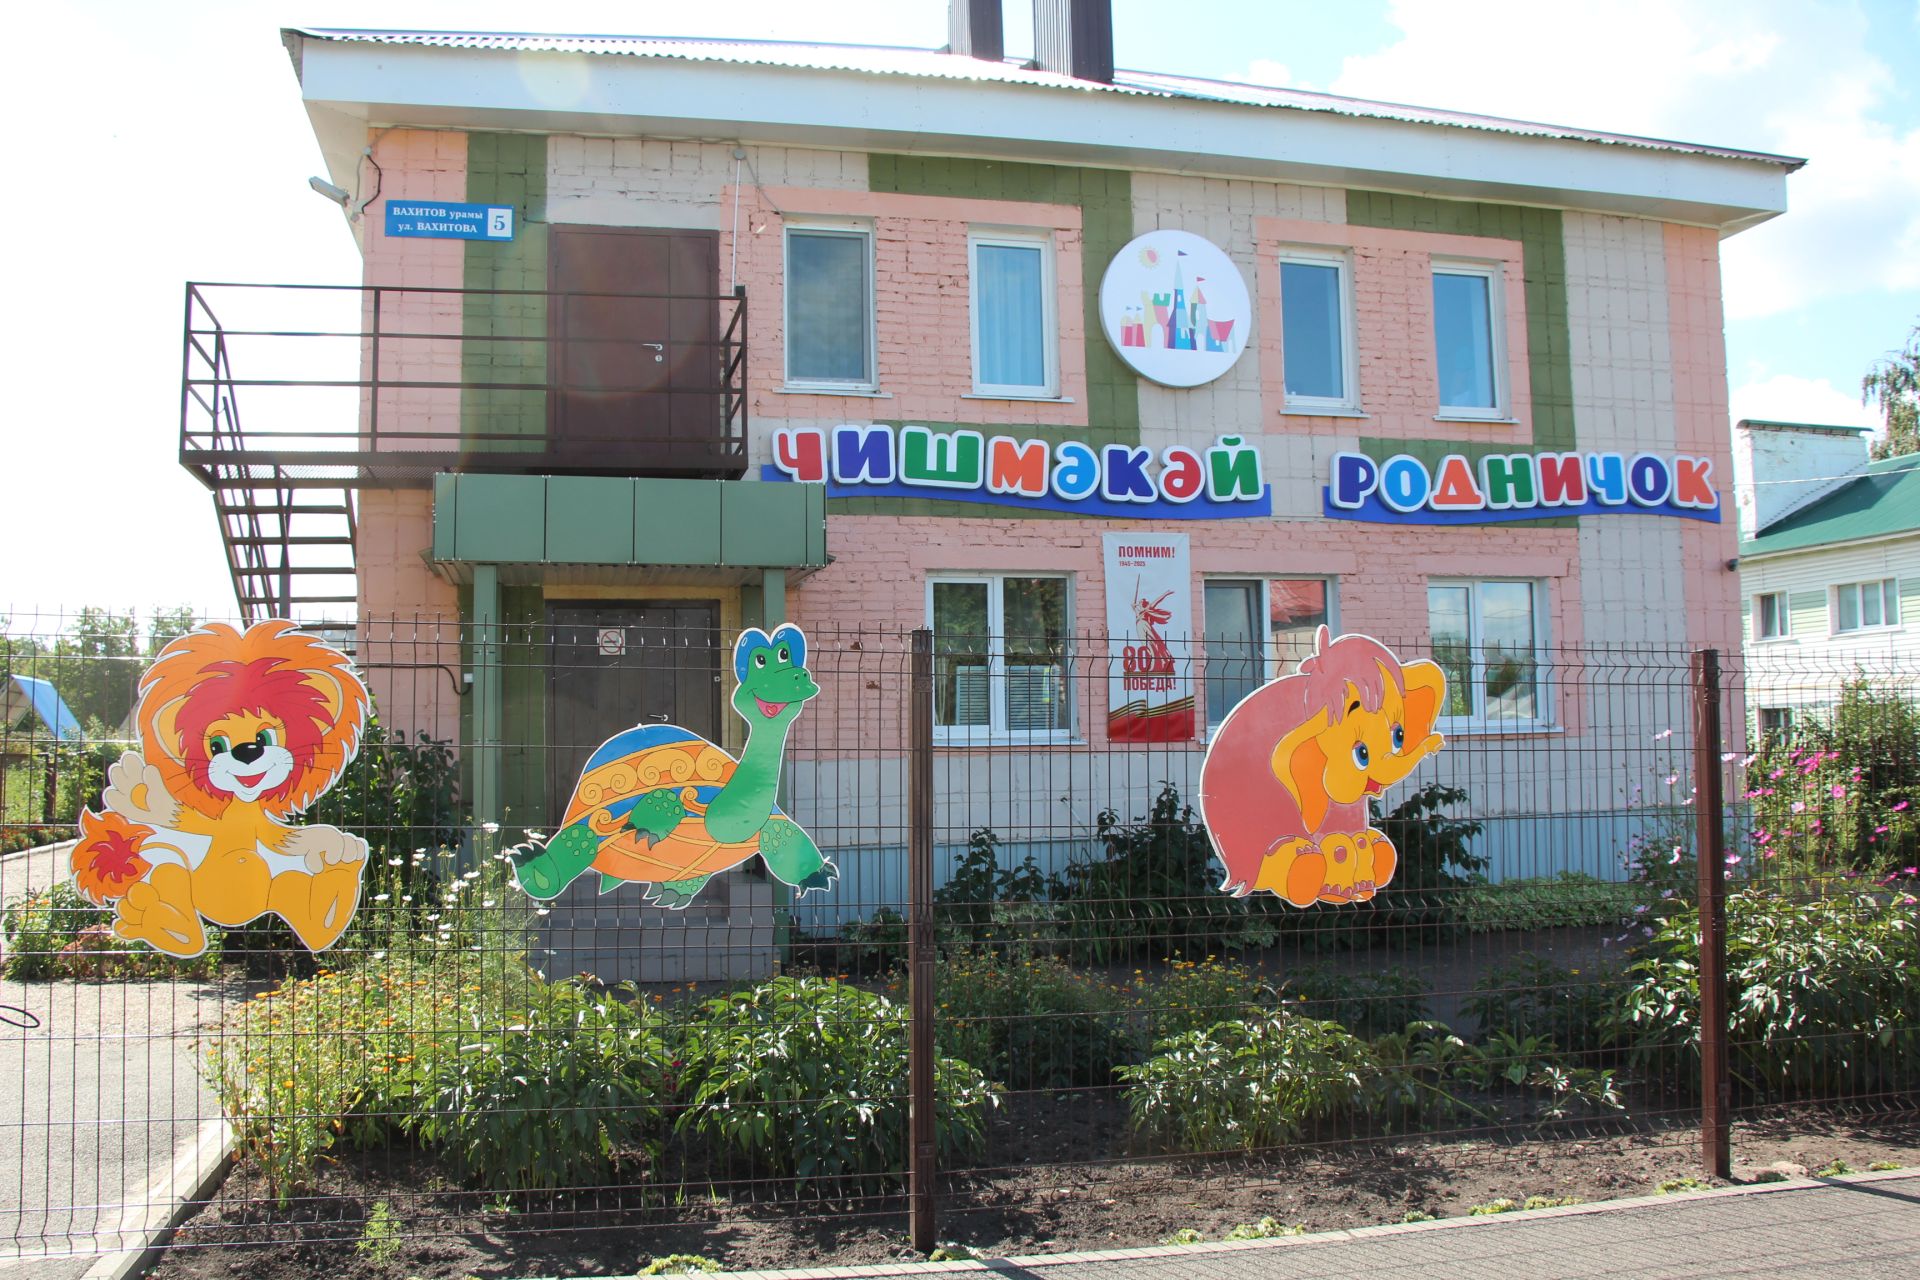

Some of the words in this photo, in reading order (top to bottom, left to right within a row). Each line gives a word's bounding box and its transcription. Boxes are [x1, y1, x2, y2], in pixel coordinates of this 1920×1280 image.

[393, 206, 447, 217] ВАХИТОВ
[449, 209, 483, 220] урамы
[398, 222, 413, 232] ул.
[417, 222, 477, 233] ВАХИТОВА
[494, 215, 506, 231] 5
[1331, 451, 1718, 512] РОДНИЧОК
[1118, 545, 1175, 559] ПОМНИМ!
[1123, 645, 1152, 672] 80
[1123, 677, 1177, 692] ПОБЕДА!
